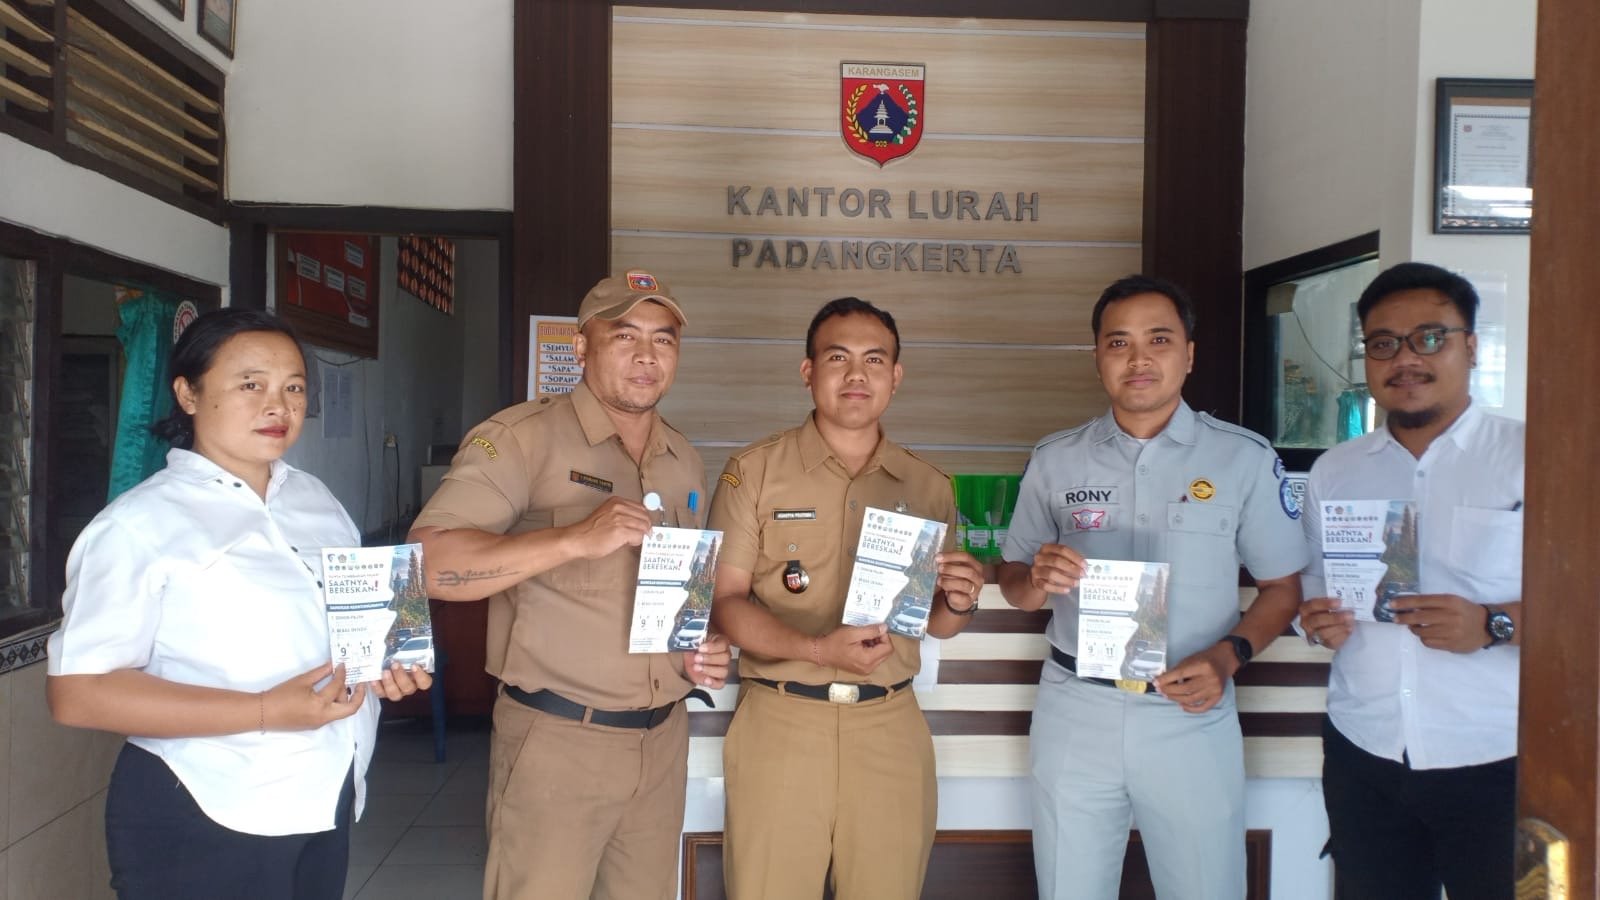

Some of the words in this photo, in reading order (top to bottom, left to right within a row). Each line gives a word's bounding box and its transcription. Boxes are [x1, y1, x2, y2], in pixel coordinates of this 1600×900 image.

[848, 66, 919, 77] KARANGASEM
[727, 185, 892, 219] KANTOR
[908, 190, 1039, 221] LURAH
[731, 237, 1023, 273] PADANGKERTA
[1065, 490, 1112, 504] RONY
[328, 579, 369, 587] SAATNYA
[362, 645, 371, 654] 11
